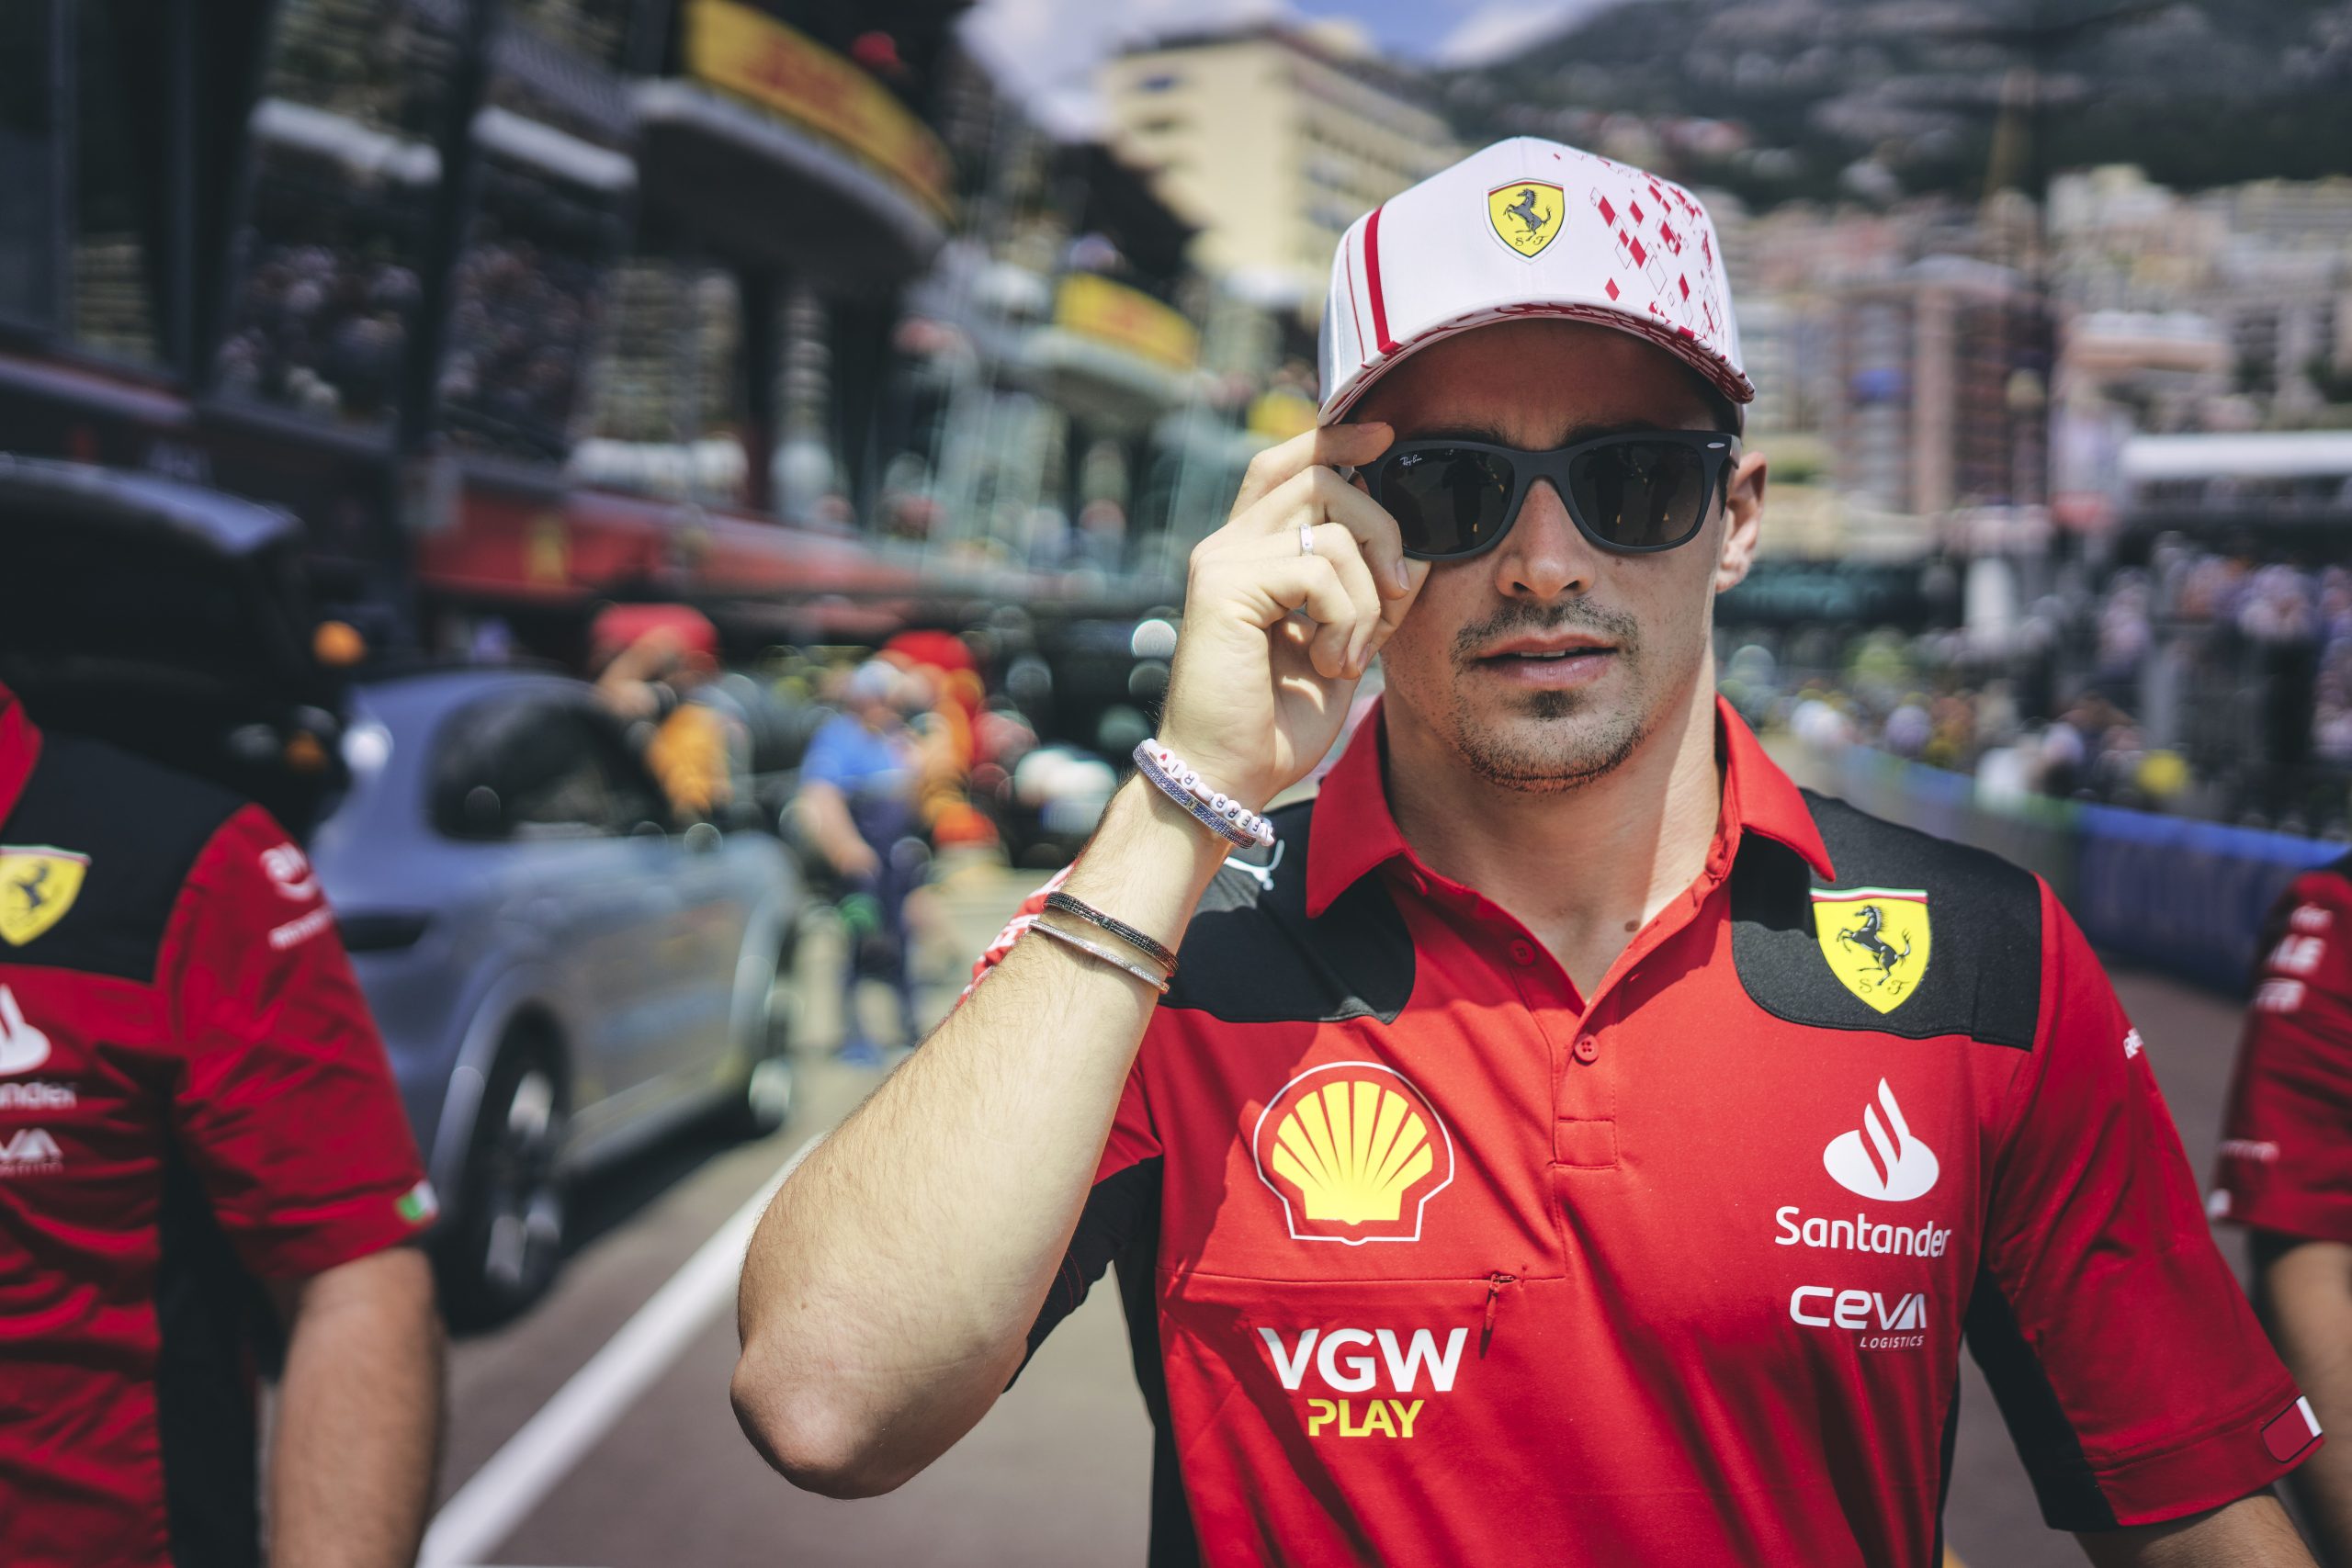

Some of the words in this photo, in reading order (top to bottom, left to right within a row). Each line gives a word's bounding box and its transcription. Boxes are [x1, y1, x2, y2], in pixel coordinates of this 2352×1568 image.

[1171, 762, 1261, 833] FERRRI
[1775, 1205, 1951, 1258] Santander
[1257, 1327, 1468, 1392] VGW
[1860, 1335, 1925, 1349] LOGISTICS
[1307, 1398, 1425, 1438] PLAY
